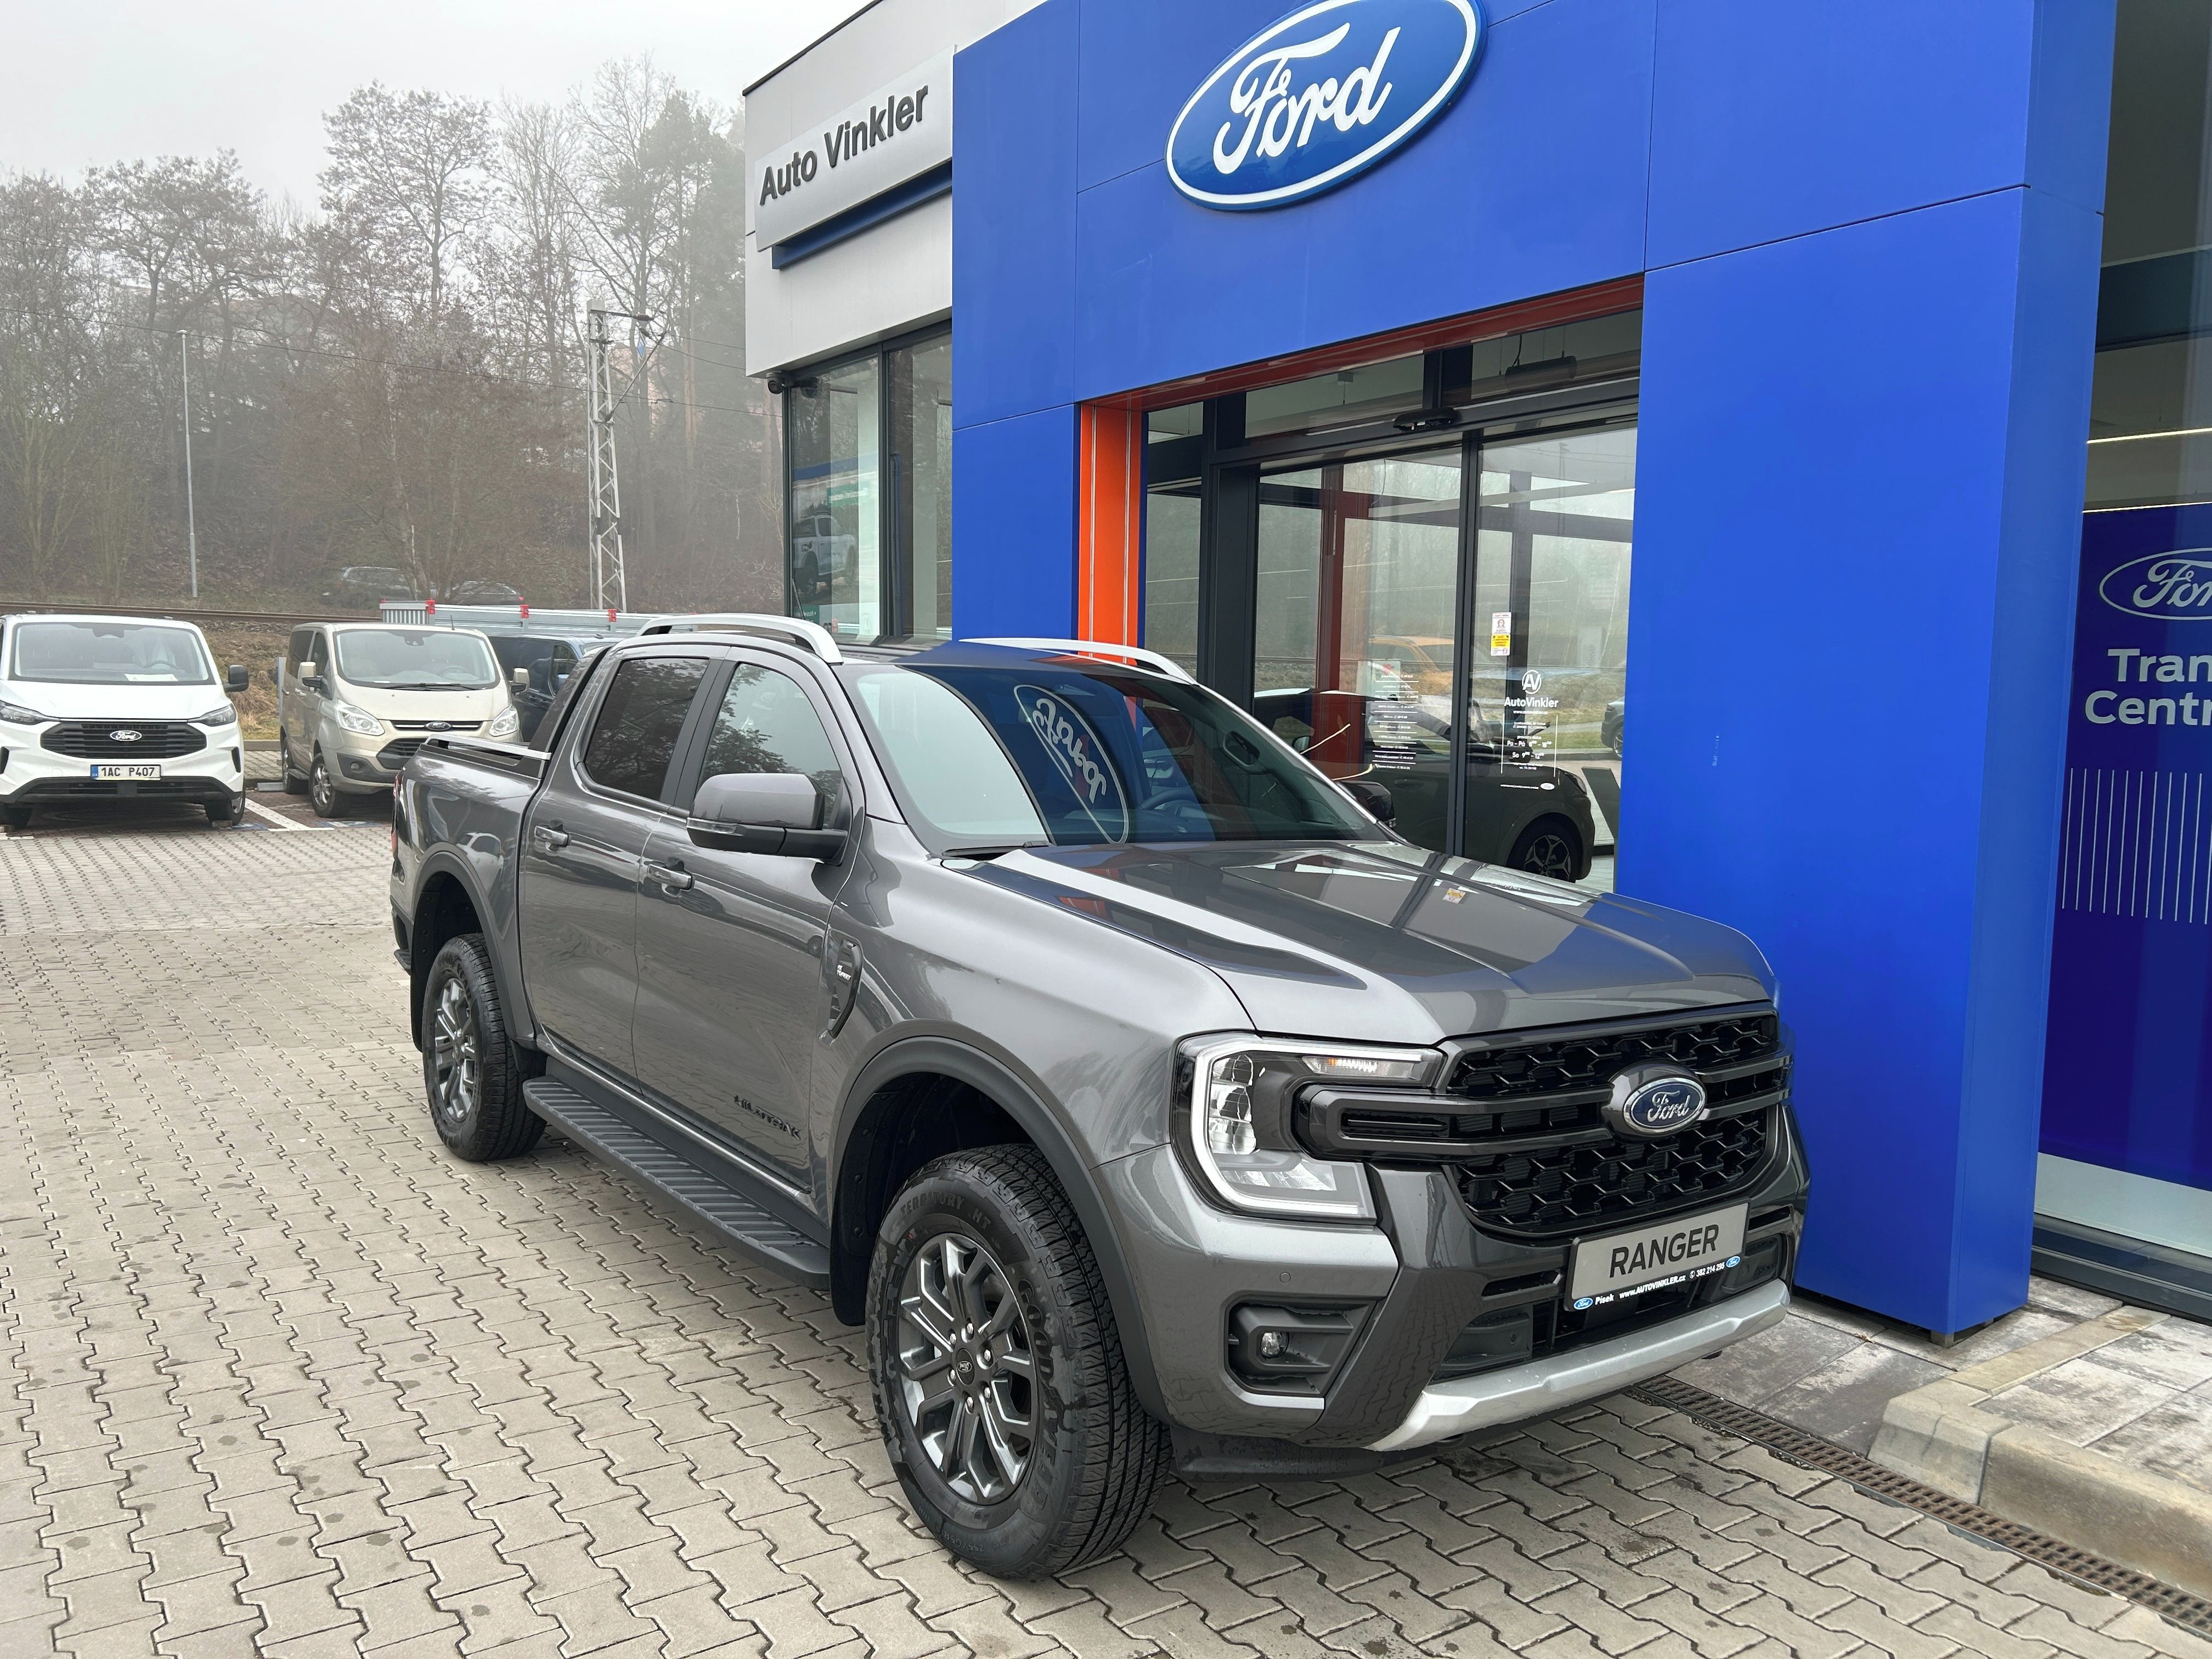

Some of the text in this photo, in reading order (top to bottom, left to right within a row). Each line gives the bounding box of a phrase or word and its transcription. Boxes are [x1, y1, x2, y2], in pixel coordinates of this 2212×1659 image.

[1213, 22, 1401, 174] Ford
[760, 84, 928, 206] Auto Vinkler
[1504, 696, 1559, 708] AutoVinkler
[101, 767, 155, 777] 1AC P407
[1646, 1089, 1691, 1123] Ford
[1609, 1224, 1720, 1278] RANGER
[1619, 1274, 1686, 1299] www.AUTOVINKLER.cz
